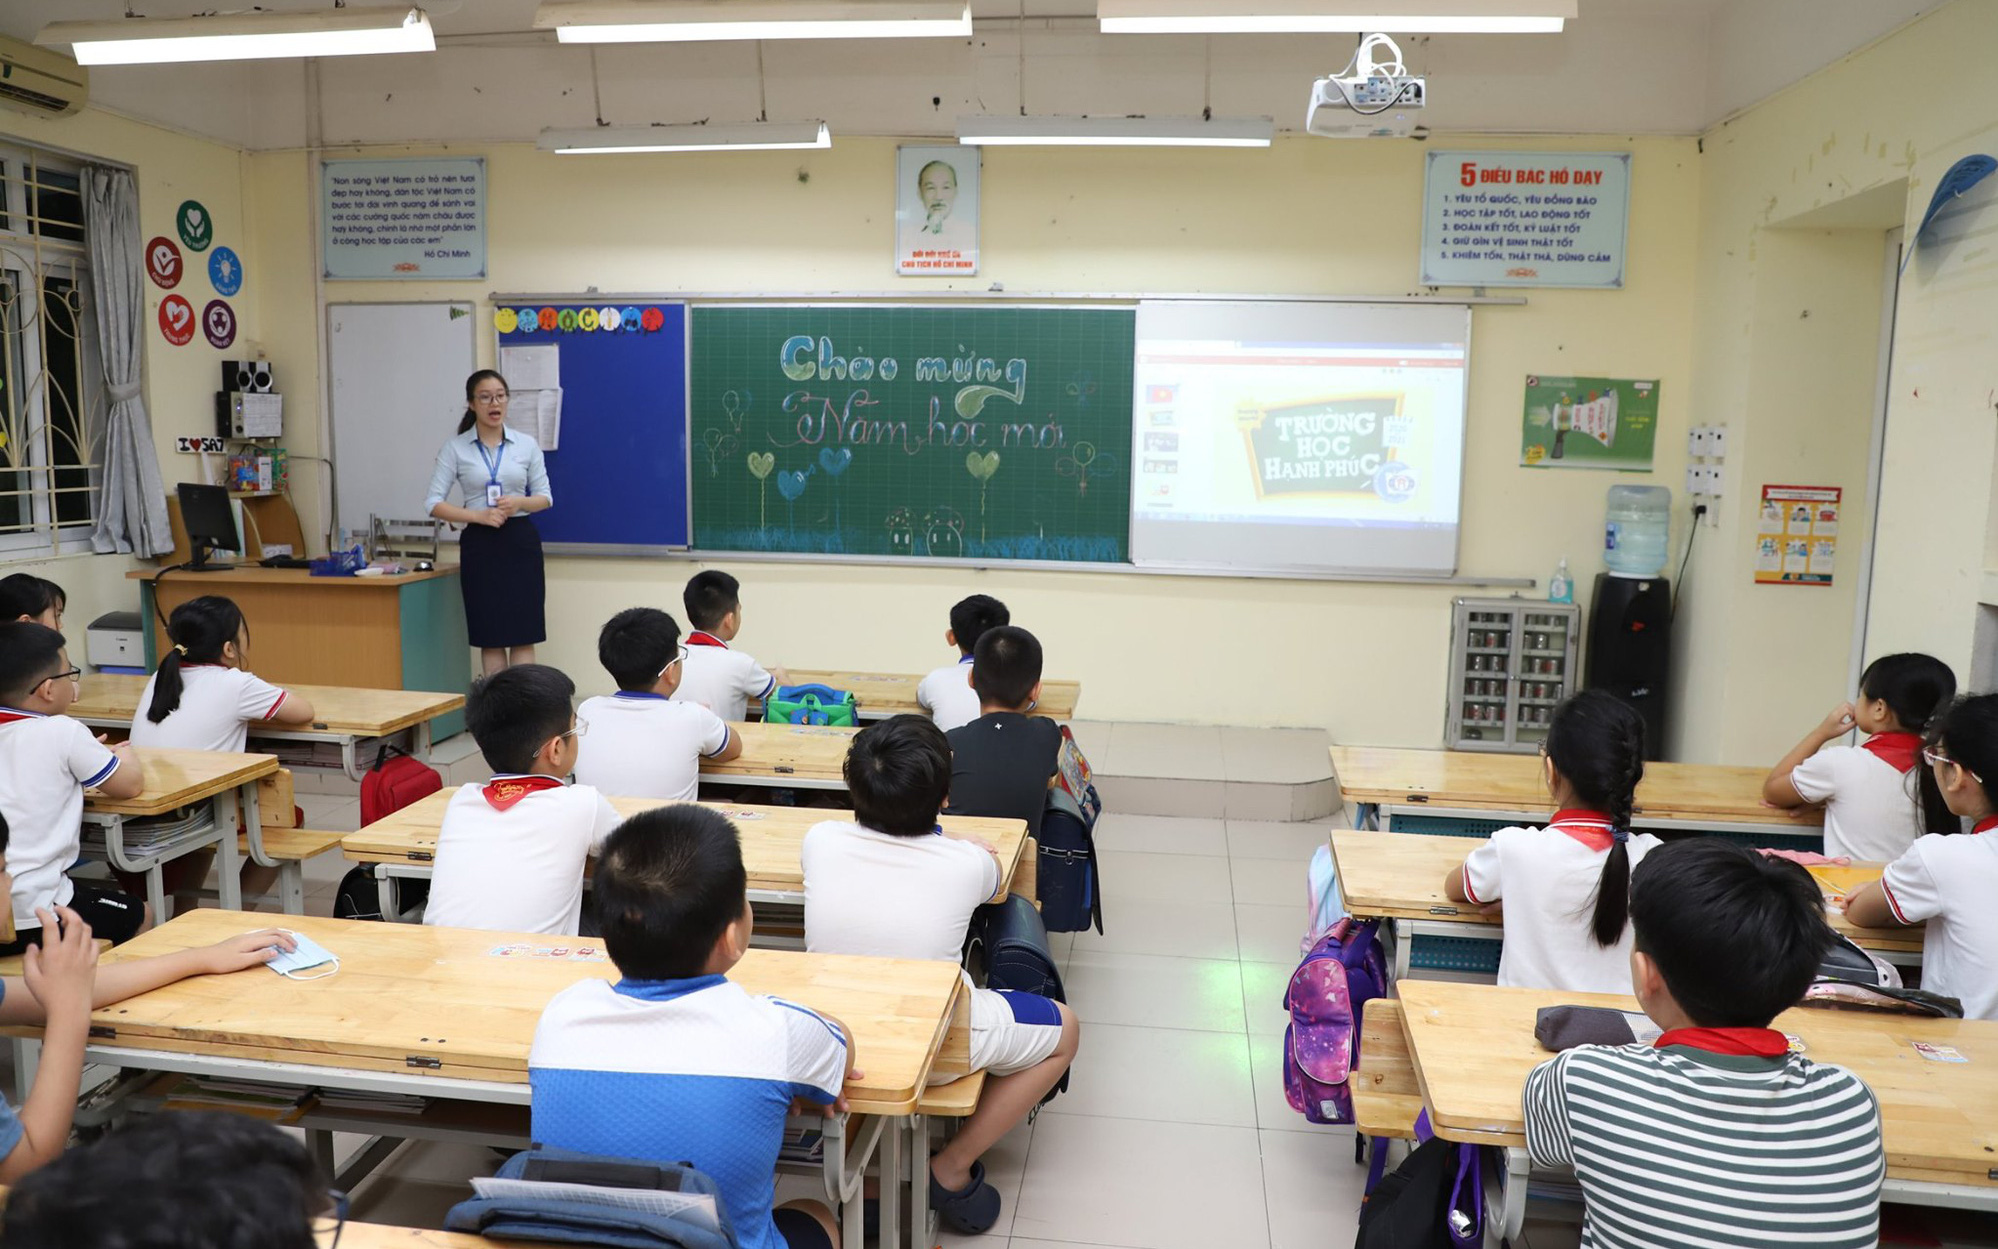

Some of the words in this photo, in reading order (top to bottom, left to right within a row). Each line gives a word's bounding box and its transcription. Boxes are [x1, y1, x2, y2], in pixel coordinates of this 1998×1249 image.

[1461, 162, 1476, 187] 5
[1481, 166, 1511, 183] ĐIỀU
[1516, 168, 1545, 184] BÁC
[1550, 167, 1569, 184] HỒ
[1573, 170, 1602, 187] DẠY
[780, 335, 898, 381] Chào
[916, 344, 1027, 419] mừng
[767, 389, 924, 455] Năm
[929, 396, 987, 447] học
[1001, 414, 1067, 448] mới
[1275, 407, 1375, 441] TRƯỜNG
[1297, 436, 1350, 461] HỌC
[1264, 457, 1320, 483] HẠNH
[1324, 453, 1379, 478] PHÚC
